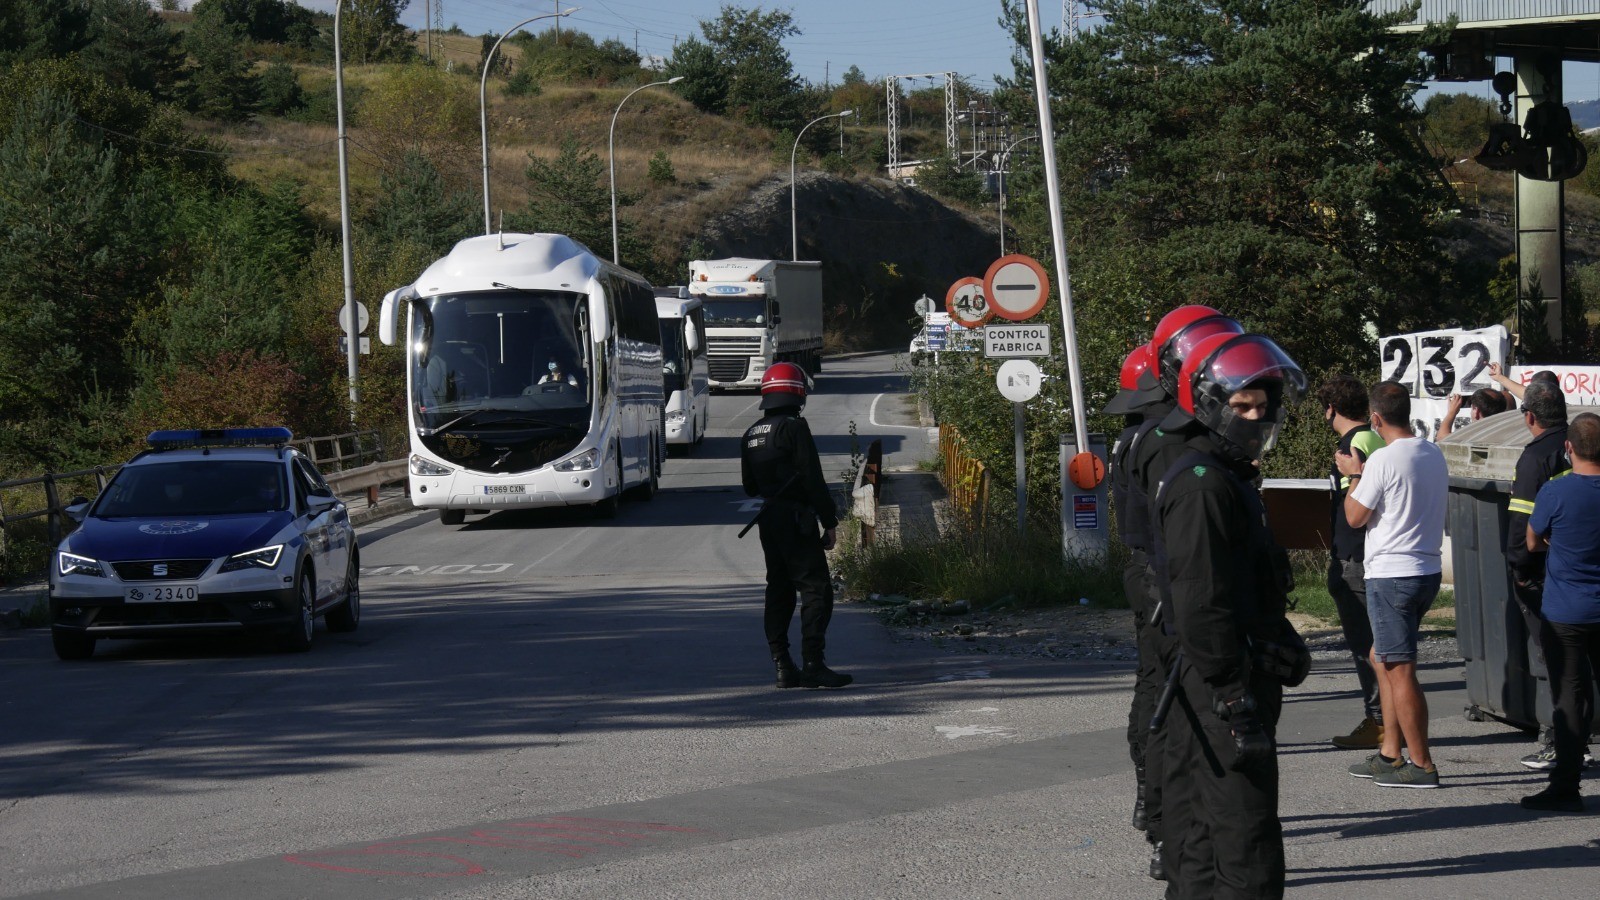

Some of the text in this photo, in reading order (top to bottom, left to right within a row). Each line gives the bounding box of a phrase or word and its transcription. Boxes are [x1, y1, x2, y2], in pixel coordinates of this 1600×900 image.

[957, 294, 986, 312] 40
[988, 330, 1046, 340] CONTROL
[992, 342, 1043, 352] FABRICA
[1383, 336, 1491, 397] 232
[489, 485, 523, 494] 5869 CXN
[154, 587, 195, 600] 2340
